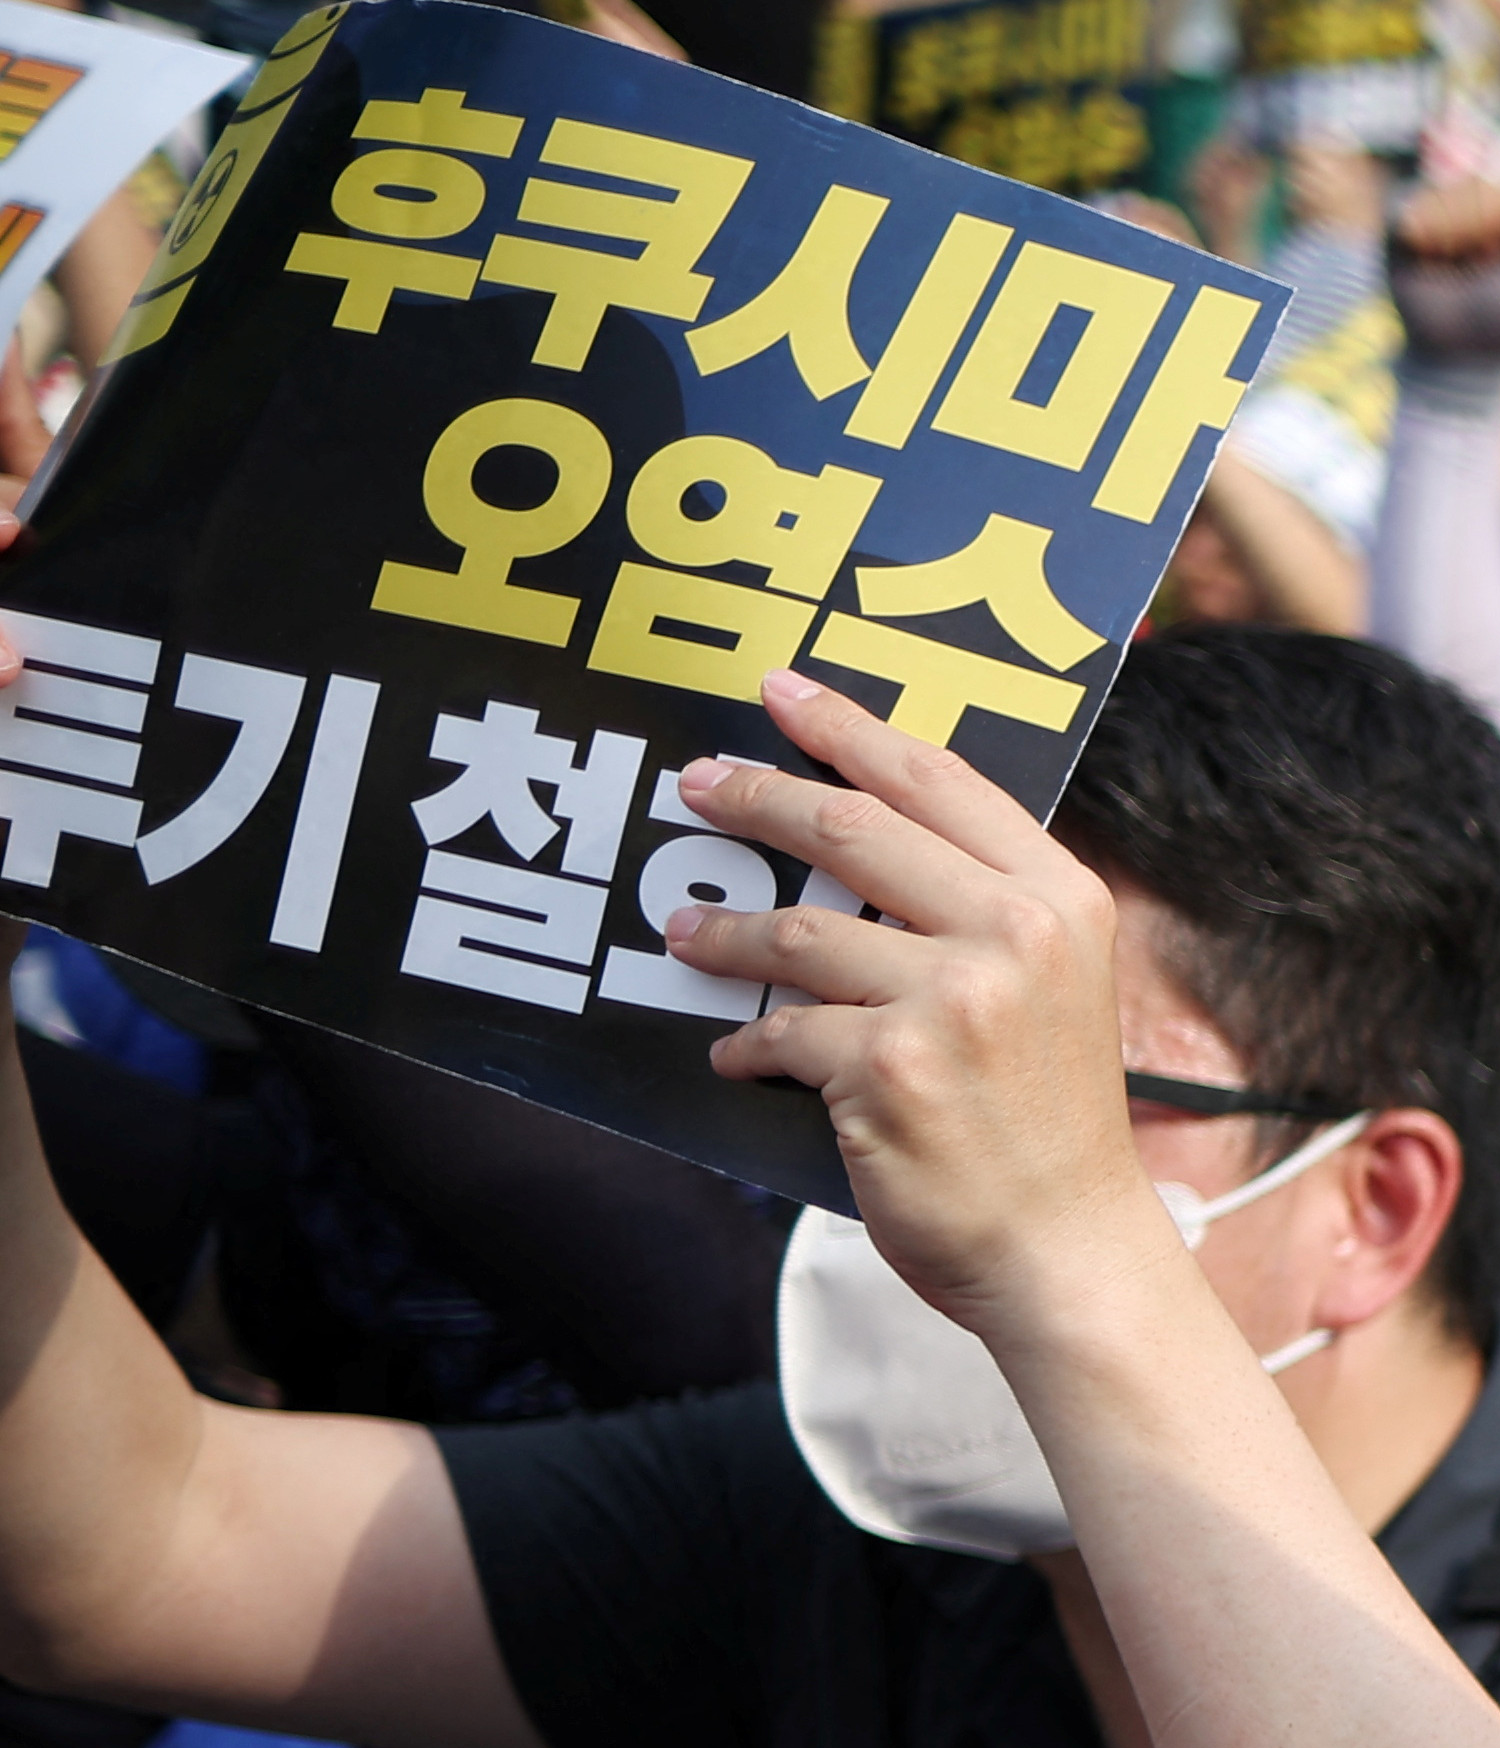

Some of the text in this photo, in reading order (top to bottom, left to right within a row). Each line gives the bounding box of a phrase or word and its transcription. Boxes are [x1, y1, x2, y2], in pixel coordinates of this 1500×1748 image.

[285, 88, 1262, 524] 후쿠시마
[371, 398, 1108, 752] 오염수
[0, 610, 381, 953] 투기
